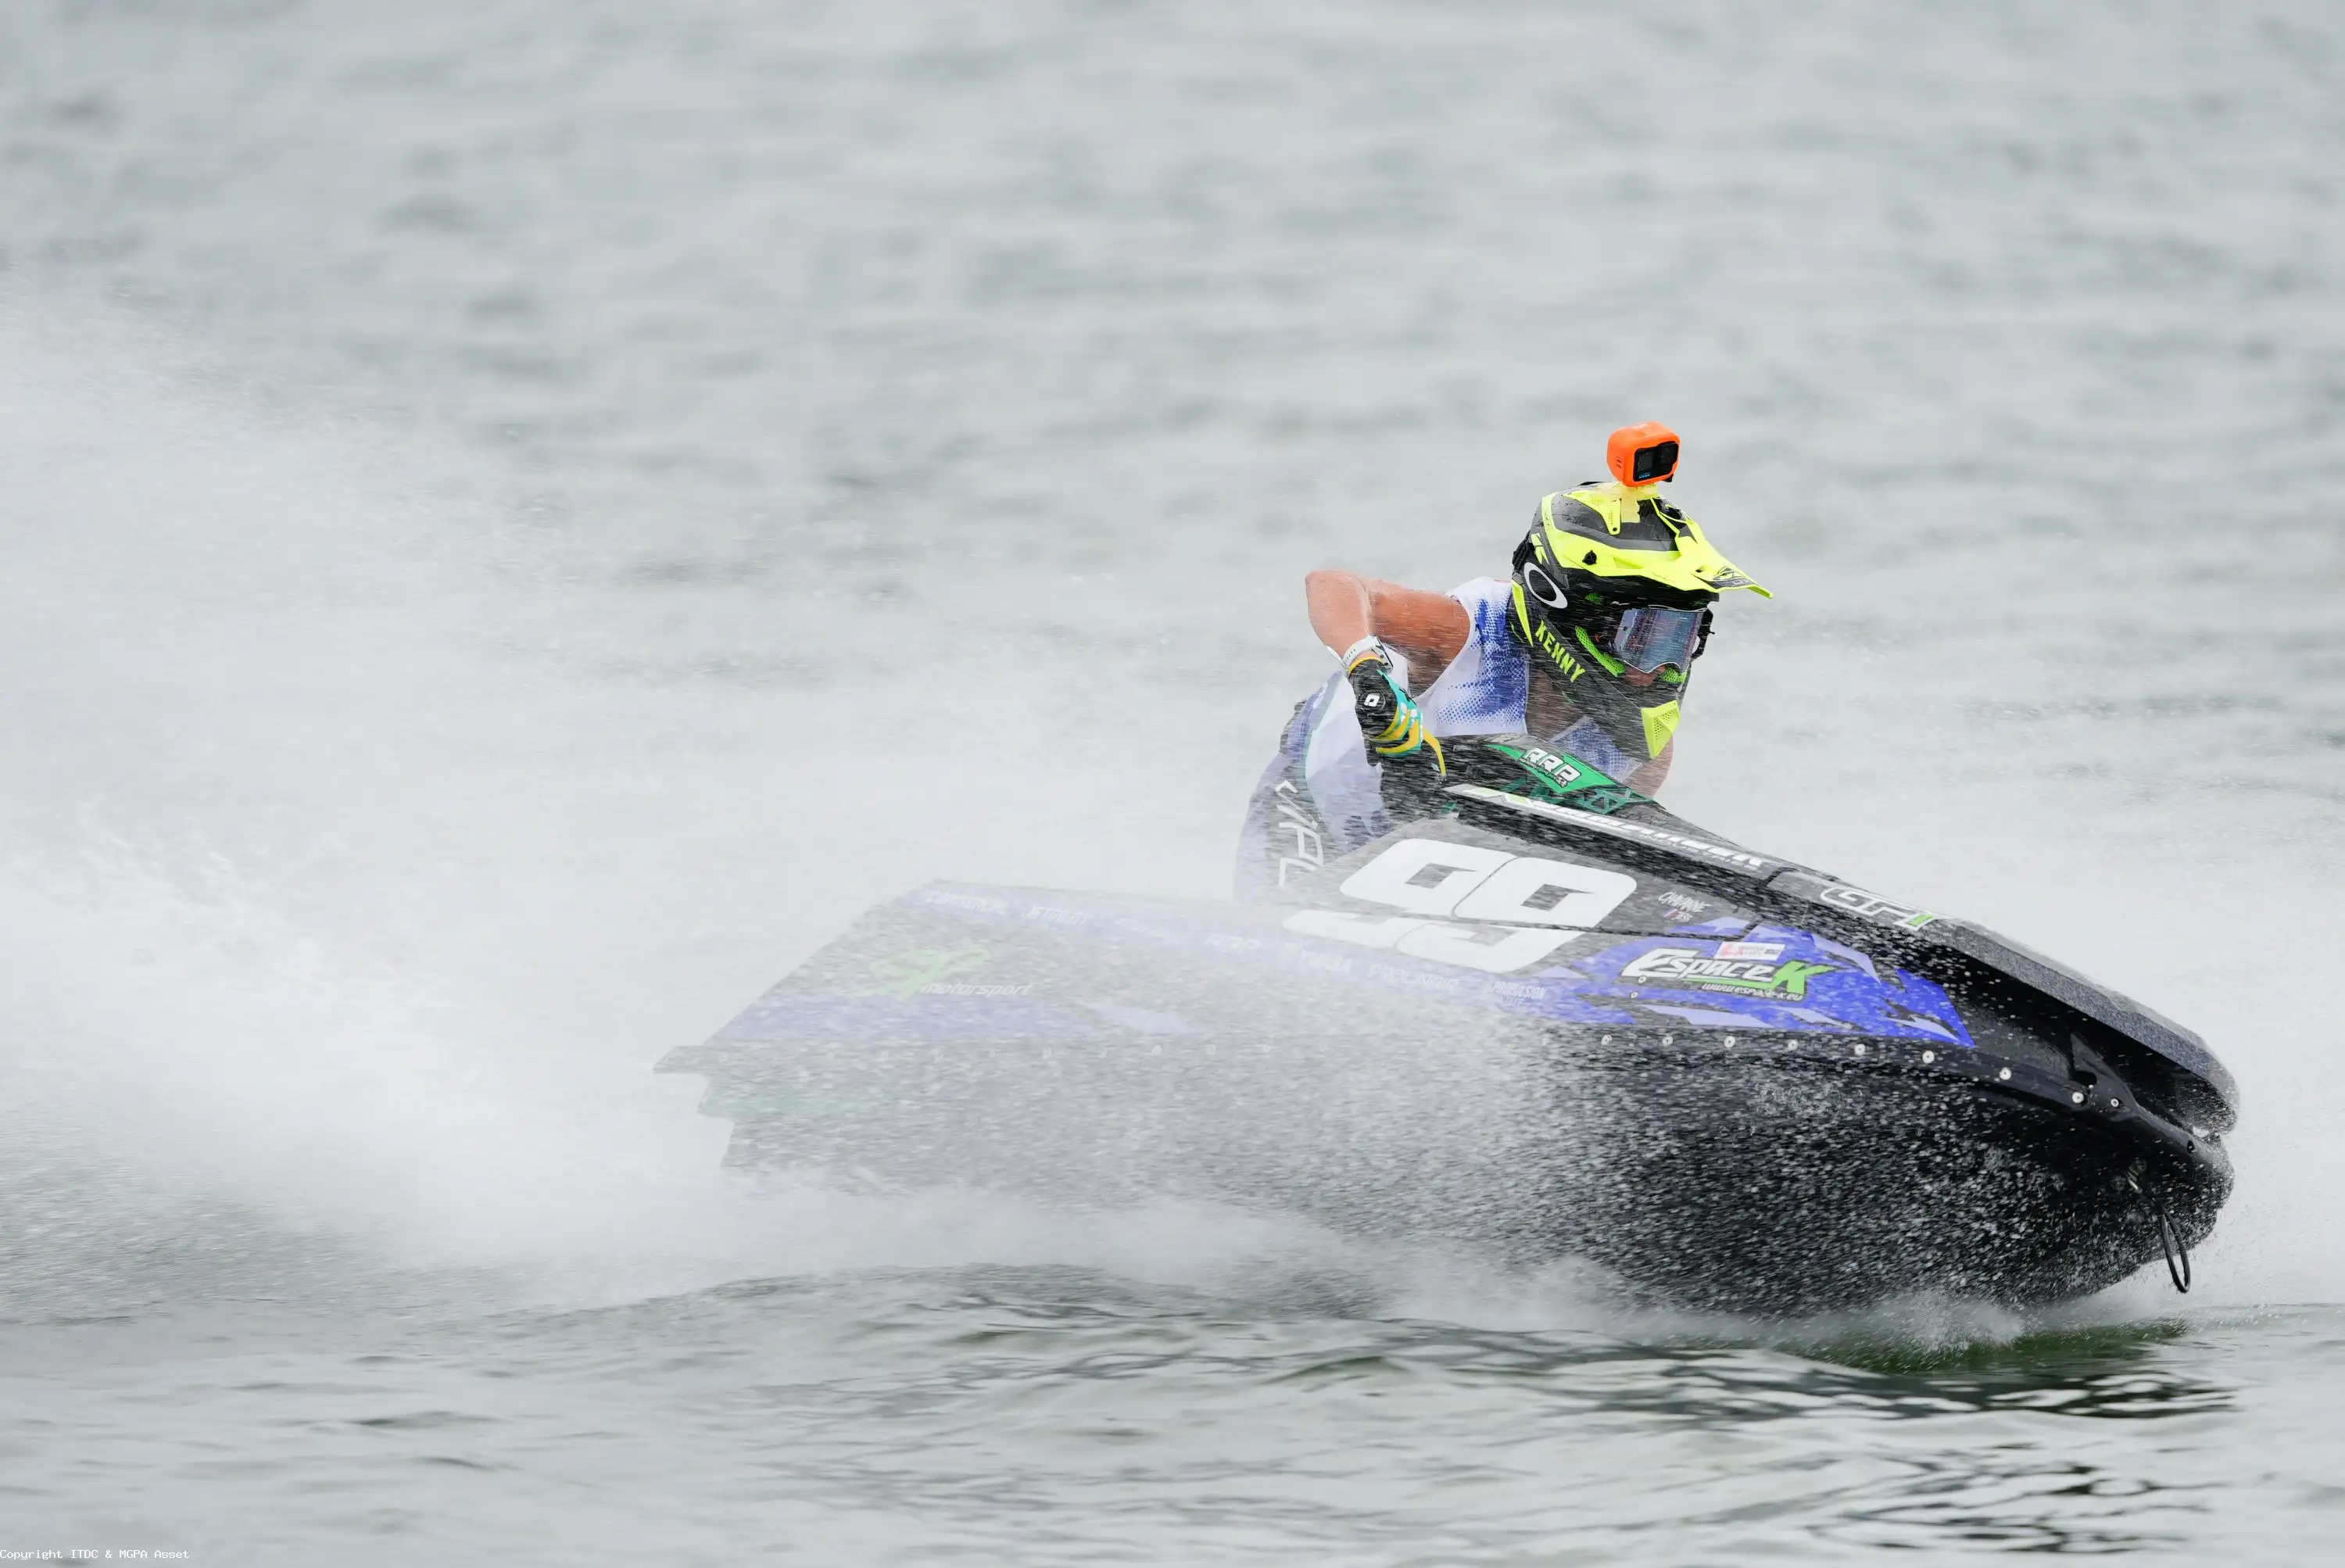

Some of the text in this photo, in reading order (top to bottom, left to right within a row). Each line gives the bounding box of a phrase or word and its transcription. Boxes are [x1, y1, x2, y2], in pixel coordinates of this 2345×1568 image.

[1534, 619, 1586, 683] KENNY
[1520, 747, 1582, 782] RRP
[1280, 838, 1638, 973] 99
